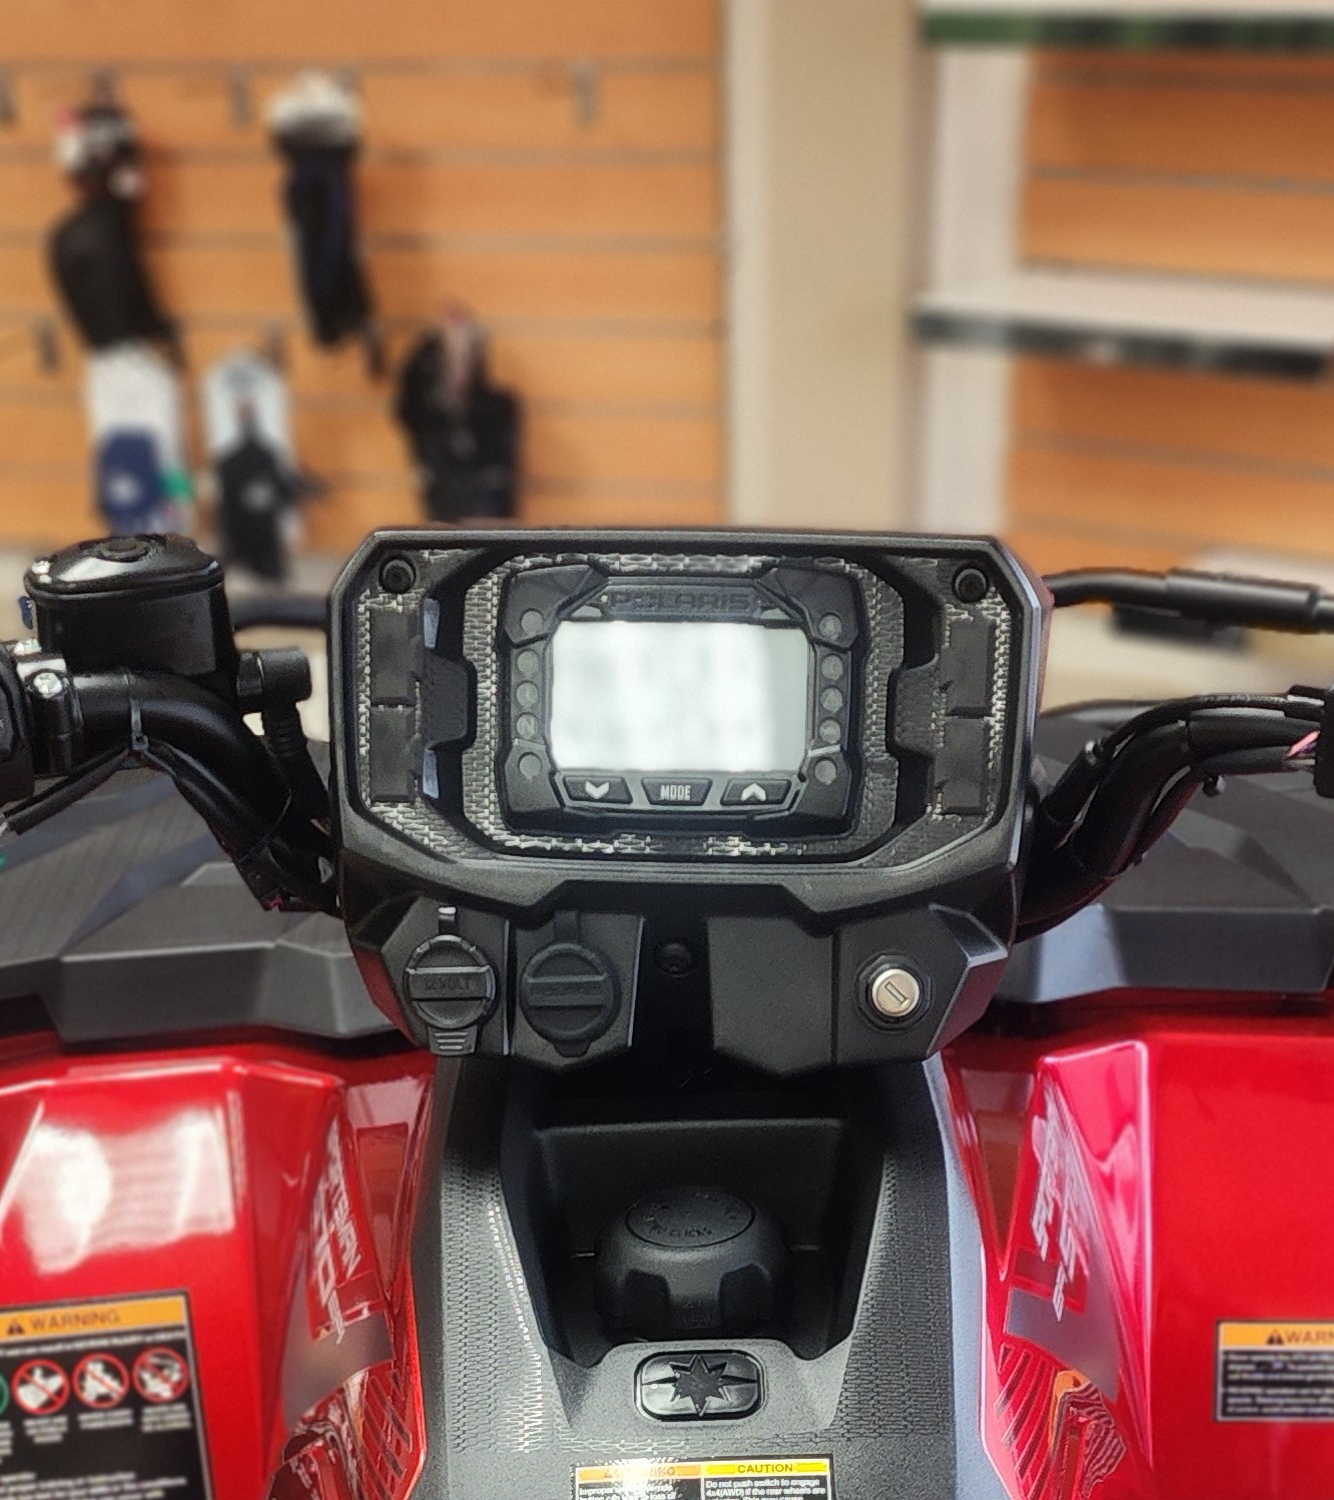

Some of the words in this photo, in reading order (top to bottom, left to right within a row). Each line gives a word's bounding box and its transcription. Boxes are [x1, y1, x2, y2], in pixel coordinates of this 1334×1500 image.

[660, 784, 691, 801] MODE
[30, 1309, 121, 1331] WARNING
[737, 1463, 793, 1474] CAUTION
